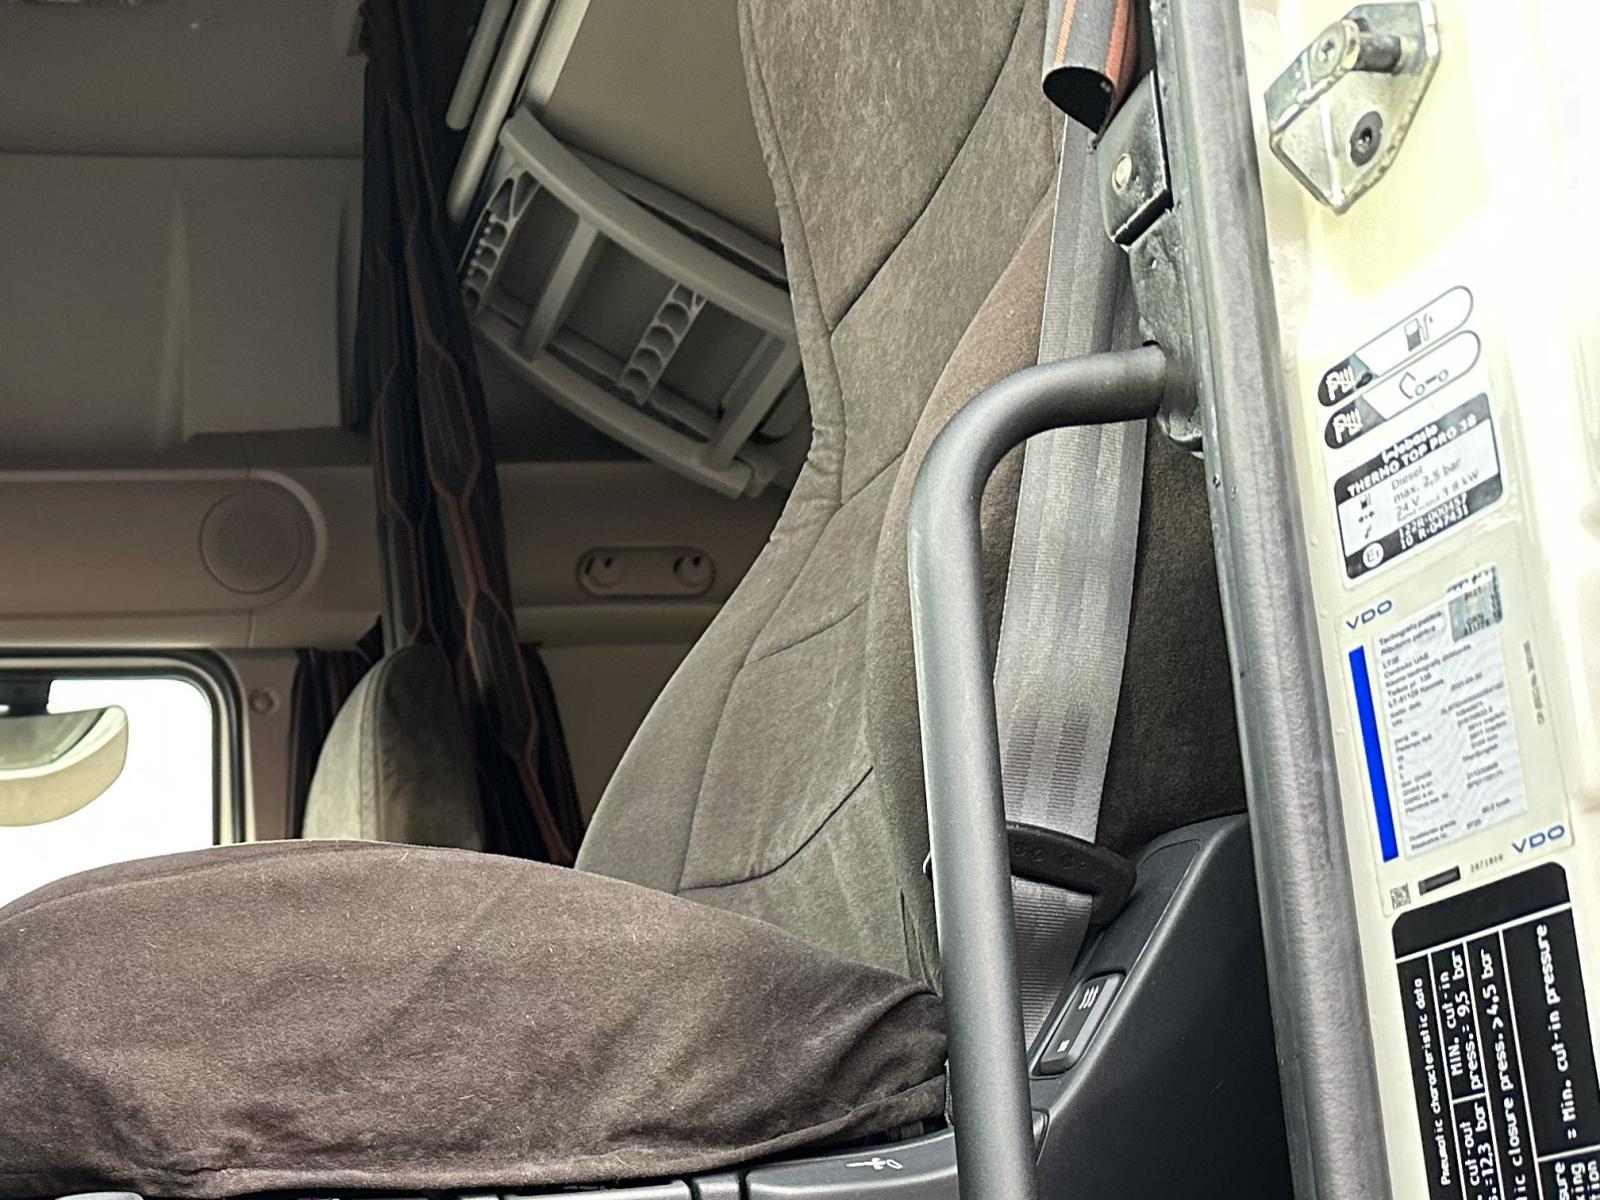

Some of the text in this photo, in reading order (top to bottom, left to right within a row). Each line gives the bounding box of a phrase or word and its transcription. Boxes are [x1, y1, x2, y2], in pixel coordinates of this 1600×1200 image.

[1347, 463, 1400, 498] THERMO
[1400, 444, 1428, 467] TOP
[1429, 427, 1457, 451] PRO
[1392, 465, 1423, 489] Diesel
[1442, 457, 1461, 476] bar
[1346, 600, 1393, 630] VDO
[1511, 823, 1566, 855] VDO
[1452, 951, 1464, 980] bar
[1481, 949, 1493, 979] bar
[1537, 925, 1560, 1004] pressure
[1439, 972, 1463, 1076] MIN. cut-in
[1455, 991, 1470, 1017] 9,5
[1548, 1011, 1568, 1071] cut-in
[1414, 978, 1450, 1185] Pneumatic characteristic data
[1495, 1033, 1513, 1091] press.
[1475, 1102, 1487, 1132] bar
[1561, 1080, 1576, 1121] Min.
[1504, 1098, 1522, 1166] closure
[1460, 1122, 1480, 1186] cut-out
